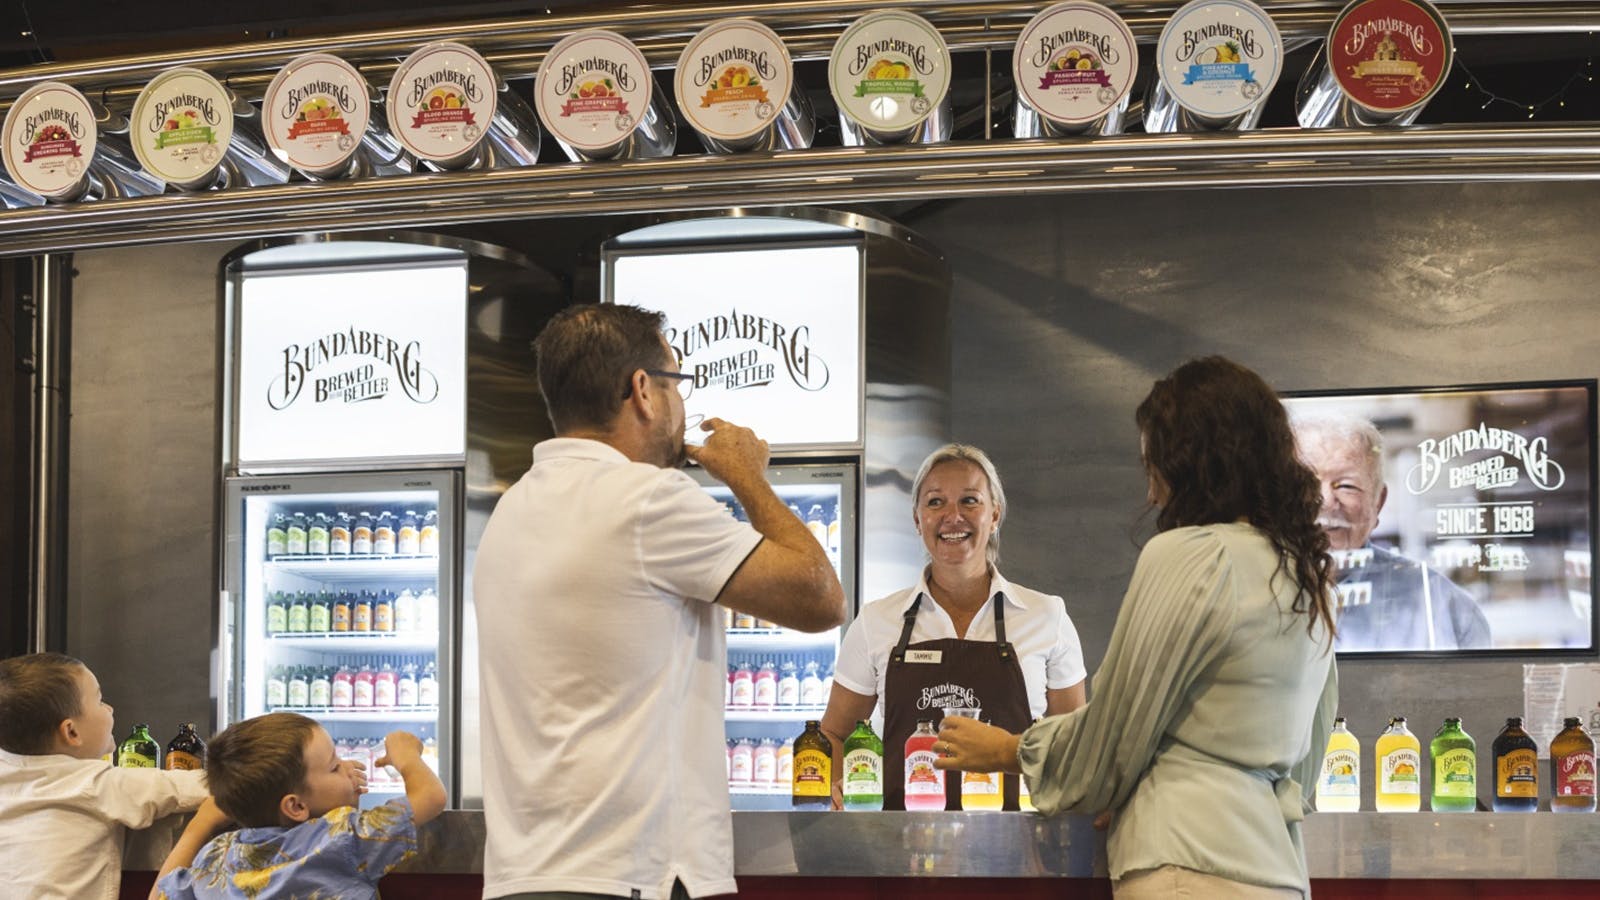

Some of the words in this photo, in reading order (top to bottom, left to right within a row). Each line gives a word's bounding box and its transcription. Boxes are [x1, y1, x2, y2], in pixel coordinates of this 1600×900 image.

[1033, 27, 1120, 68] BUNDABERG
[1176, 21, 1264, 62] BUNDABERG
[1345, 16, 1433, 56] BUNDABERG
[555, 56, 636, 96] BUNDABERG
[694, 45, 777, 87] BUNDABERG
[848, 37, 934, 76] BUNDABERG
[281, 80, 357, 119] BUNDABERG
[406, 68, 483, 108] BUNDABERG
[20, 106, 86, 145] BUNDABERG
[150, 92, 221, 133] BUNDABERG
[267, 324, 439, 410] BUNDABERG
[315, 364, 374, 402] BREWED
[695, 349, 758, 389] BREWED
[726, 363, 774, 390] BETTER
[344, 377, 389, 403] BETTER
[1405, 421, 1565, 495] BUNDABERG
[1450, 455, 1504, 489] BREWED
[1476, 466, 1519, 490] BETTER
[1436, 507, 1487, 535] SINCE
[1493, 505, 1534, 533] 1968
[916, 682, 981, 710] BUNDABERG
